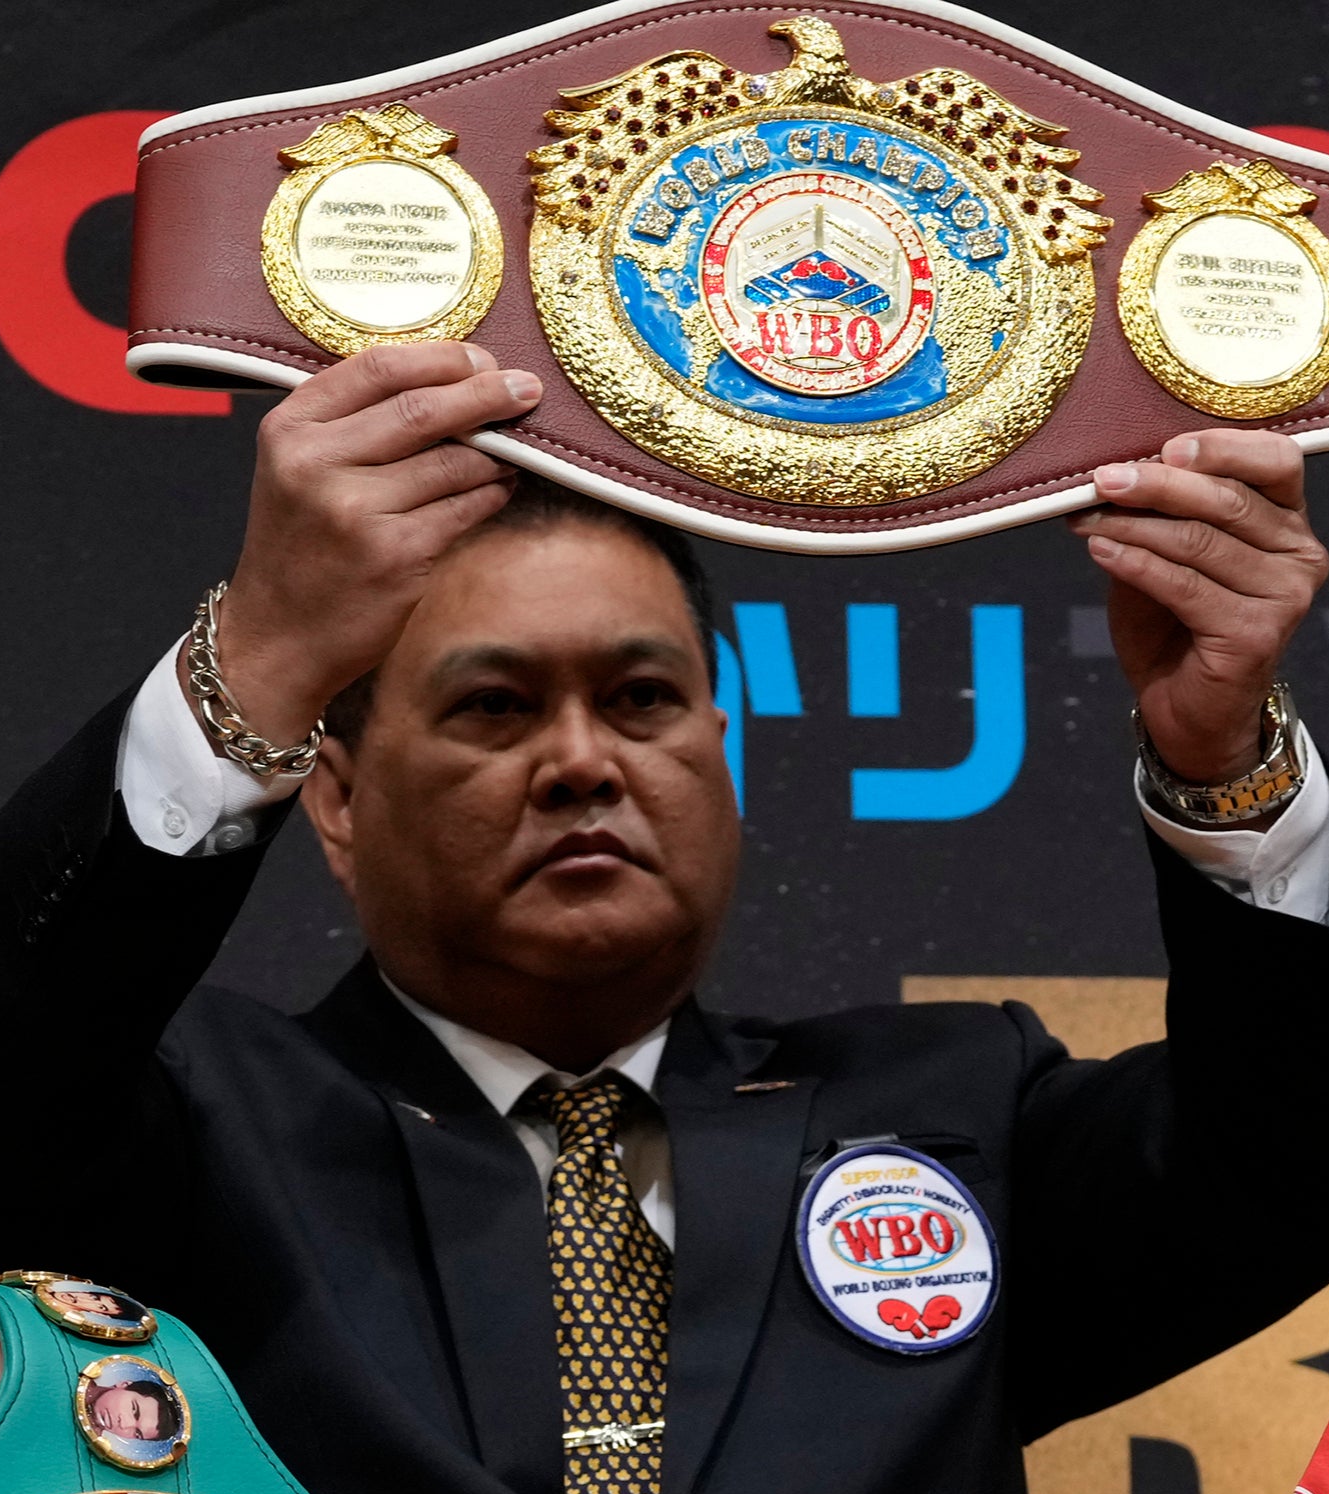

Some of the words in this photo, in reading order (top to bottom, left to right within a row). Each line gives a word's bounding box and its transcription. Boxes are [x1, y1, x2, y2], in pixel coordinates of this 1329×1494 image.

[634, 136, 770, 240] WORLD
[787, 127, 1002, 260] CHAMPION
[752, 311, 883, 362] WBO
[835, 1211, 955, 1262] WBO
[833, 1284, 870, 1297] WORLD
[873, 1278, 912, 1292] BOXING
